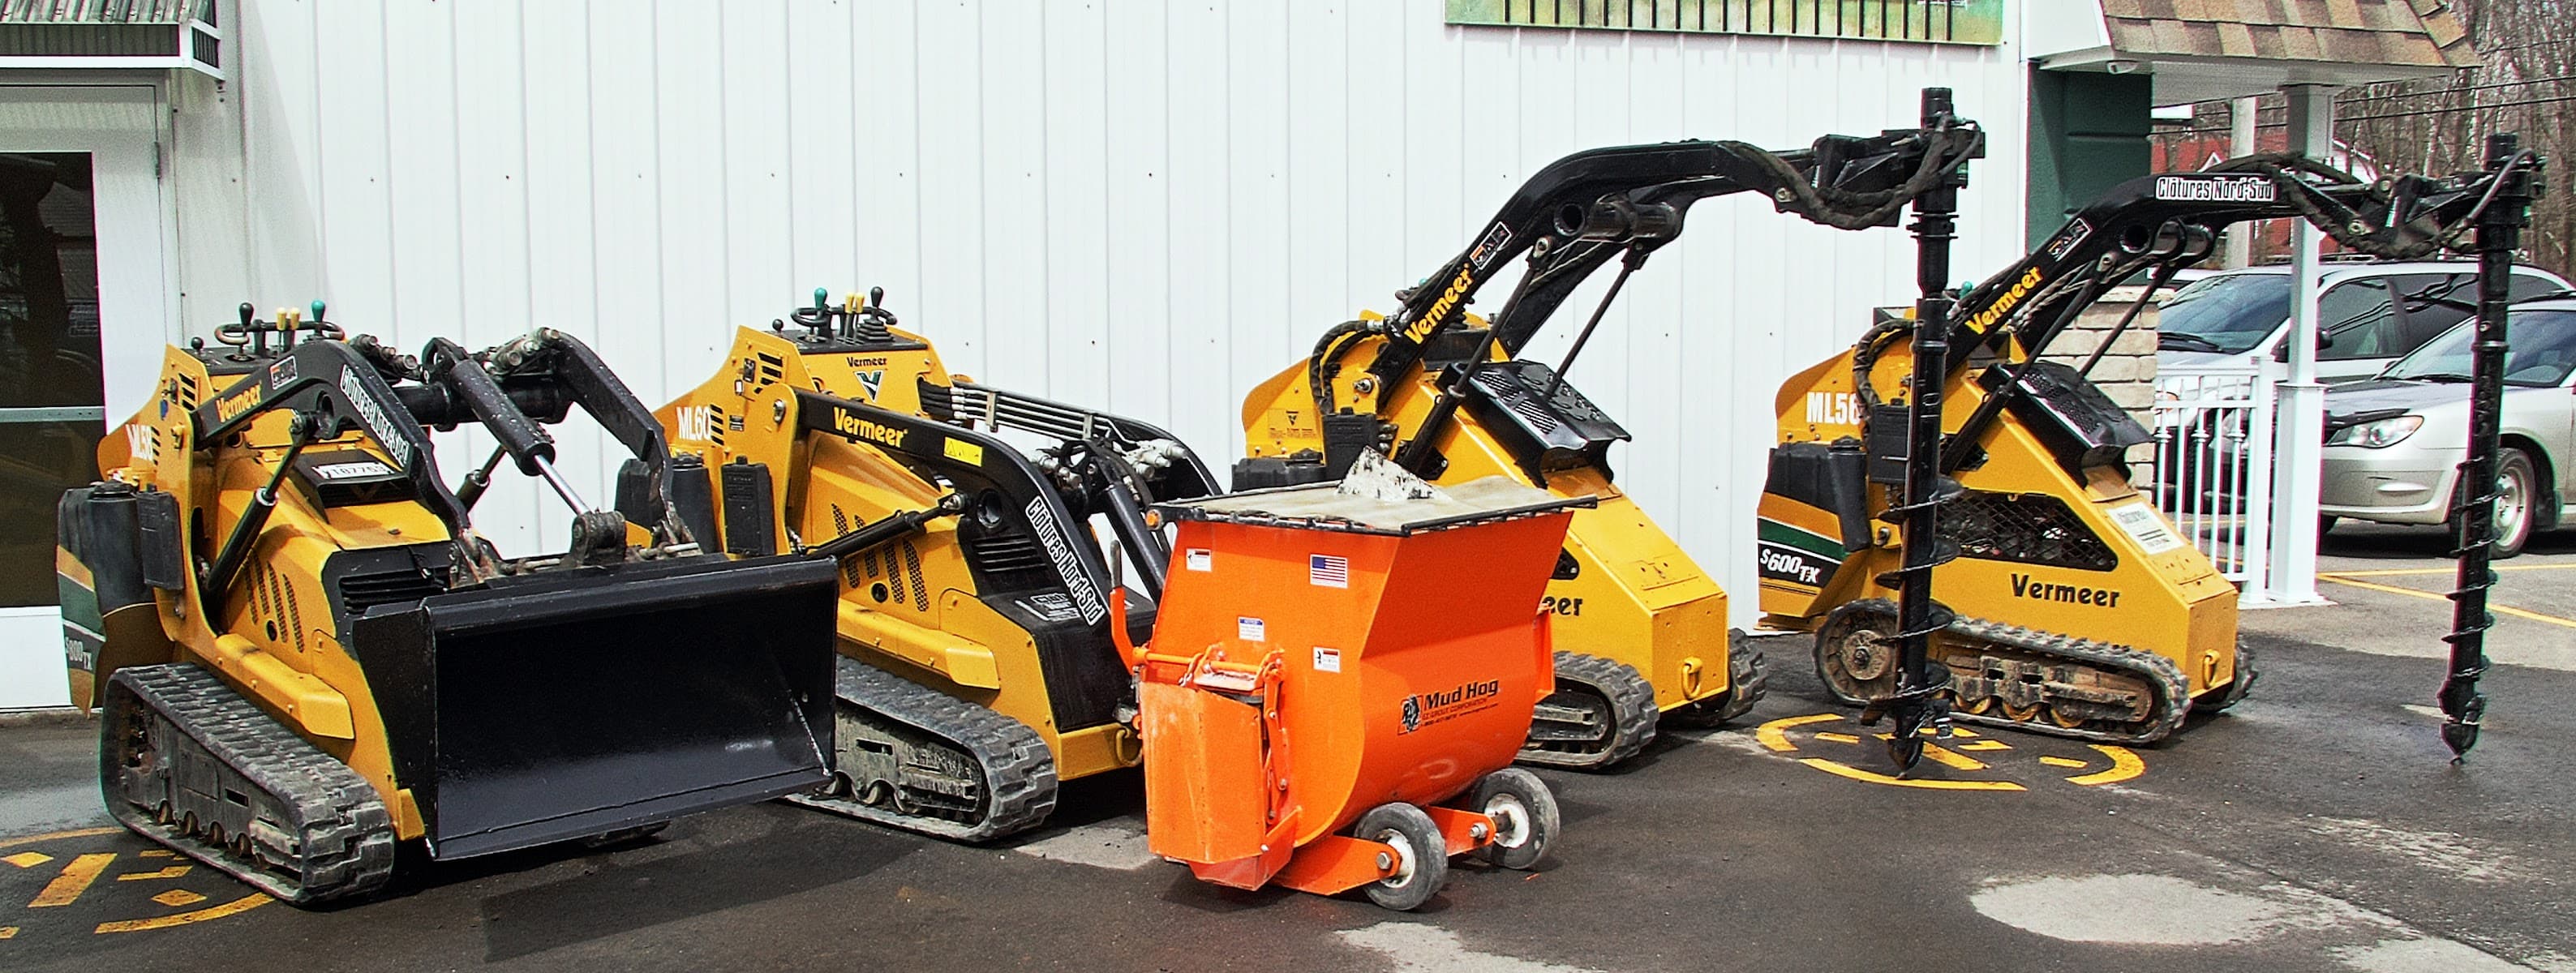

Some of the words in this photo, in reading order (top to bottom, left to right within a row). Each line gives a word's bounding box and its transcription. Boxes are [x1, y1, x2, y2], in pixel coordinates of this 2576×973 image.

[2156, 177, 2212, 200] Clôtures
[1404, 268, 1474, 344] Vermeer
[1965, 267, 2043, 335] Vermeer
[847, 357, 887, 367] Vermeer
[216, 384, 262, 423] Vermeer
[676, 405, 711, 439] ML60
[834, 406, 903, 448] Vermeer
[1026, 496, 1067, 564] Clôtures
[1058, 551, 1106, 626] Nord-Sud
[2011, 573, 2120, 607] Vermeer
[1424, 686, 1462, 710] Mud
[1466, 680, 1499, 699] Hog
